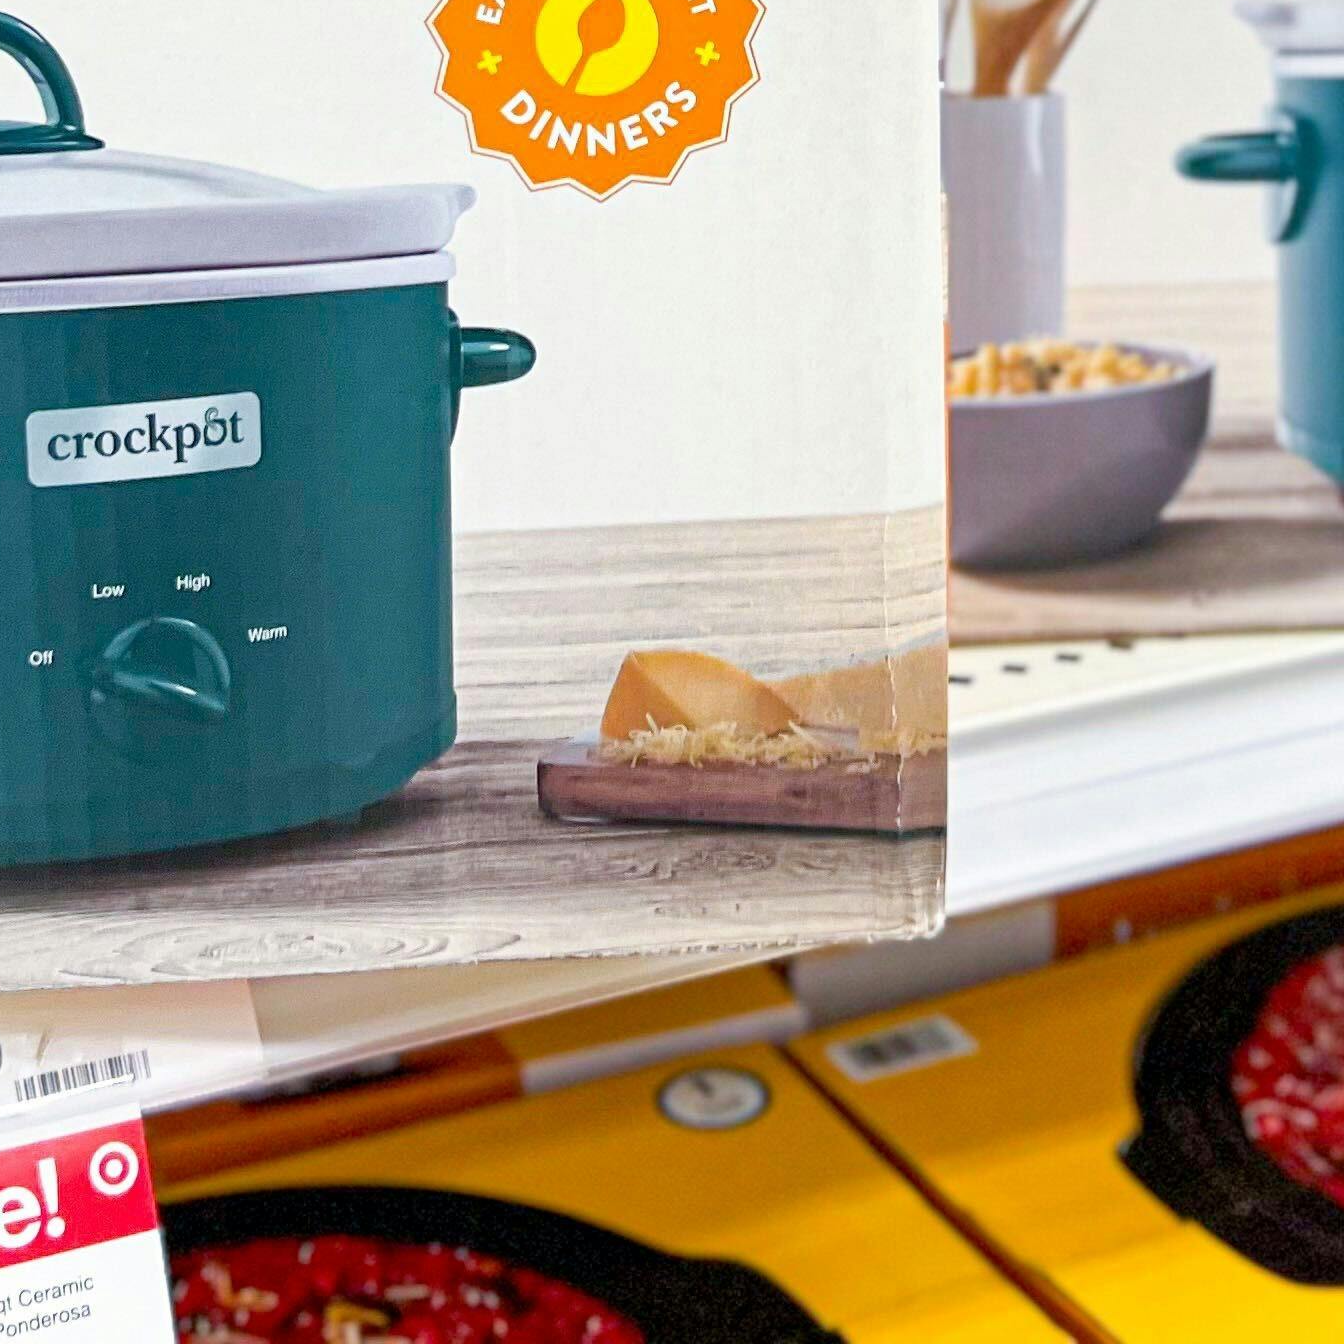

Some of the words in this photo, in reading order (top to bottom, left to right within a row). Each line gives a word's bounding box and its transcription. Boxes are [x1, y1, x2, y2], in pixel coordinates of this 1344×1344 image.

[500, 81, 697, 156] DINNERS
[47, 407, 244, 464] crockpot
[92, 583, 125, 599] Low
[176, 574, 211, 592] High
[248, 625, 288, 643] Warm
[29, 650, 53, 666] Off
[18, 1276, 95, 1307] Ceramic
